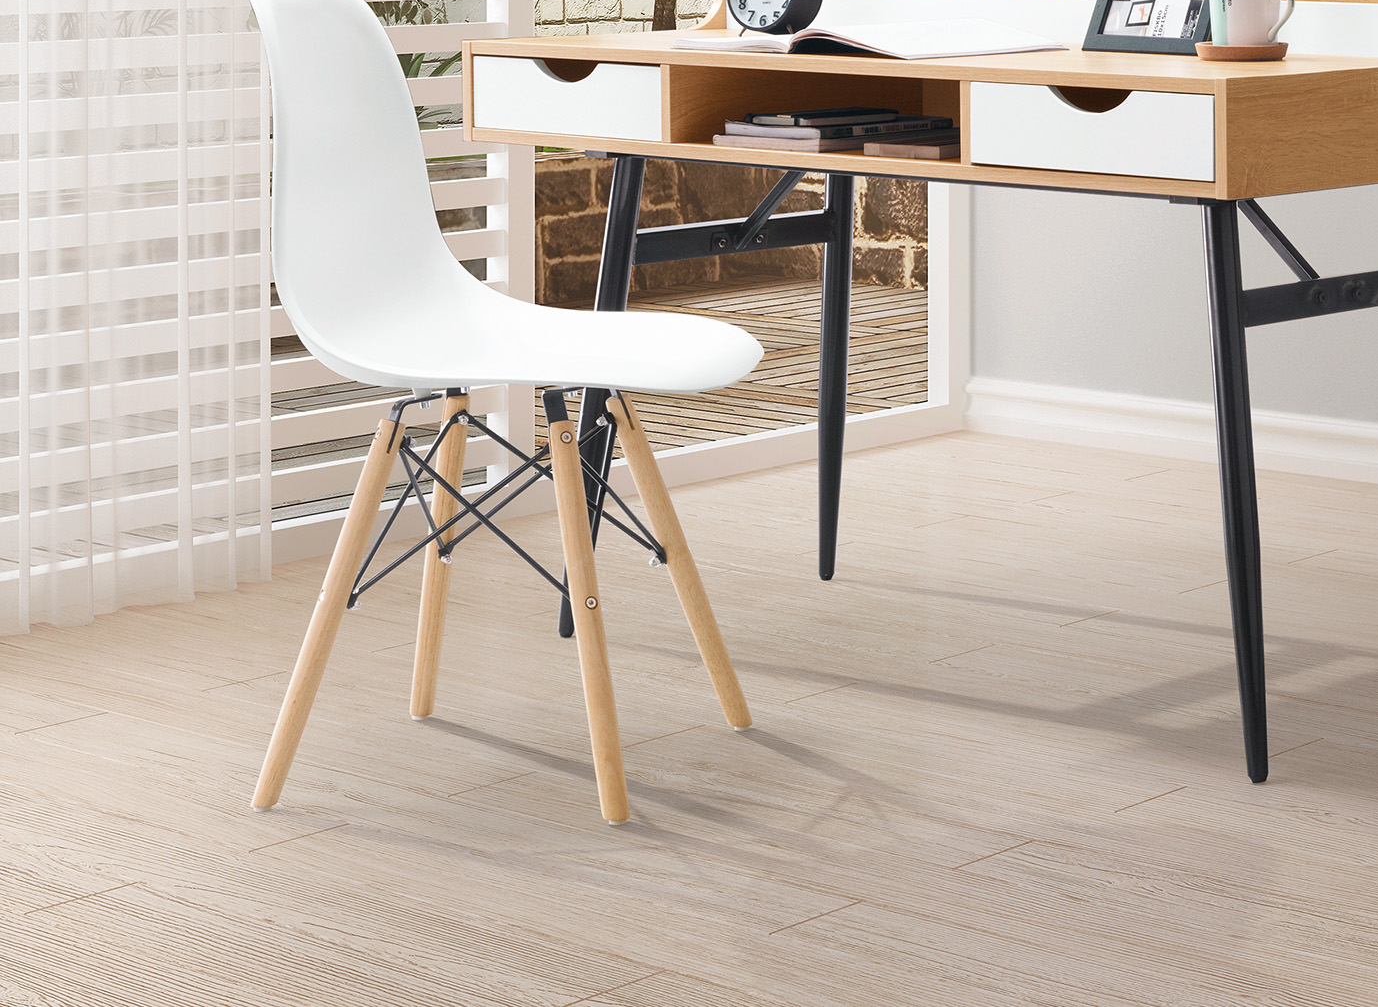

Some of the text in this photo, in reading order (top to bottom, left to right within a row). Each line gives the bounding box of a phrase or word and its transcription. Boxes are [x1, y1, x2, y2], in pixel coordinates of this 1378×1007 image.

[782, 0, 789, 9] 4
[748, 10, 755, 22] 7
[760, 15, 767, 26] 6
[772, 11, 780, 22] 5
